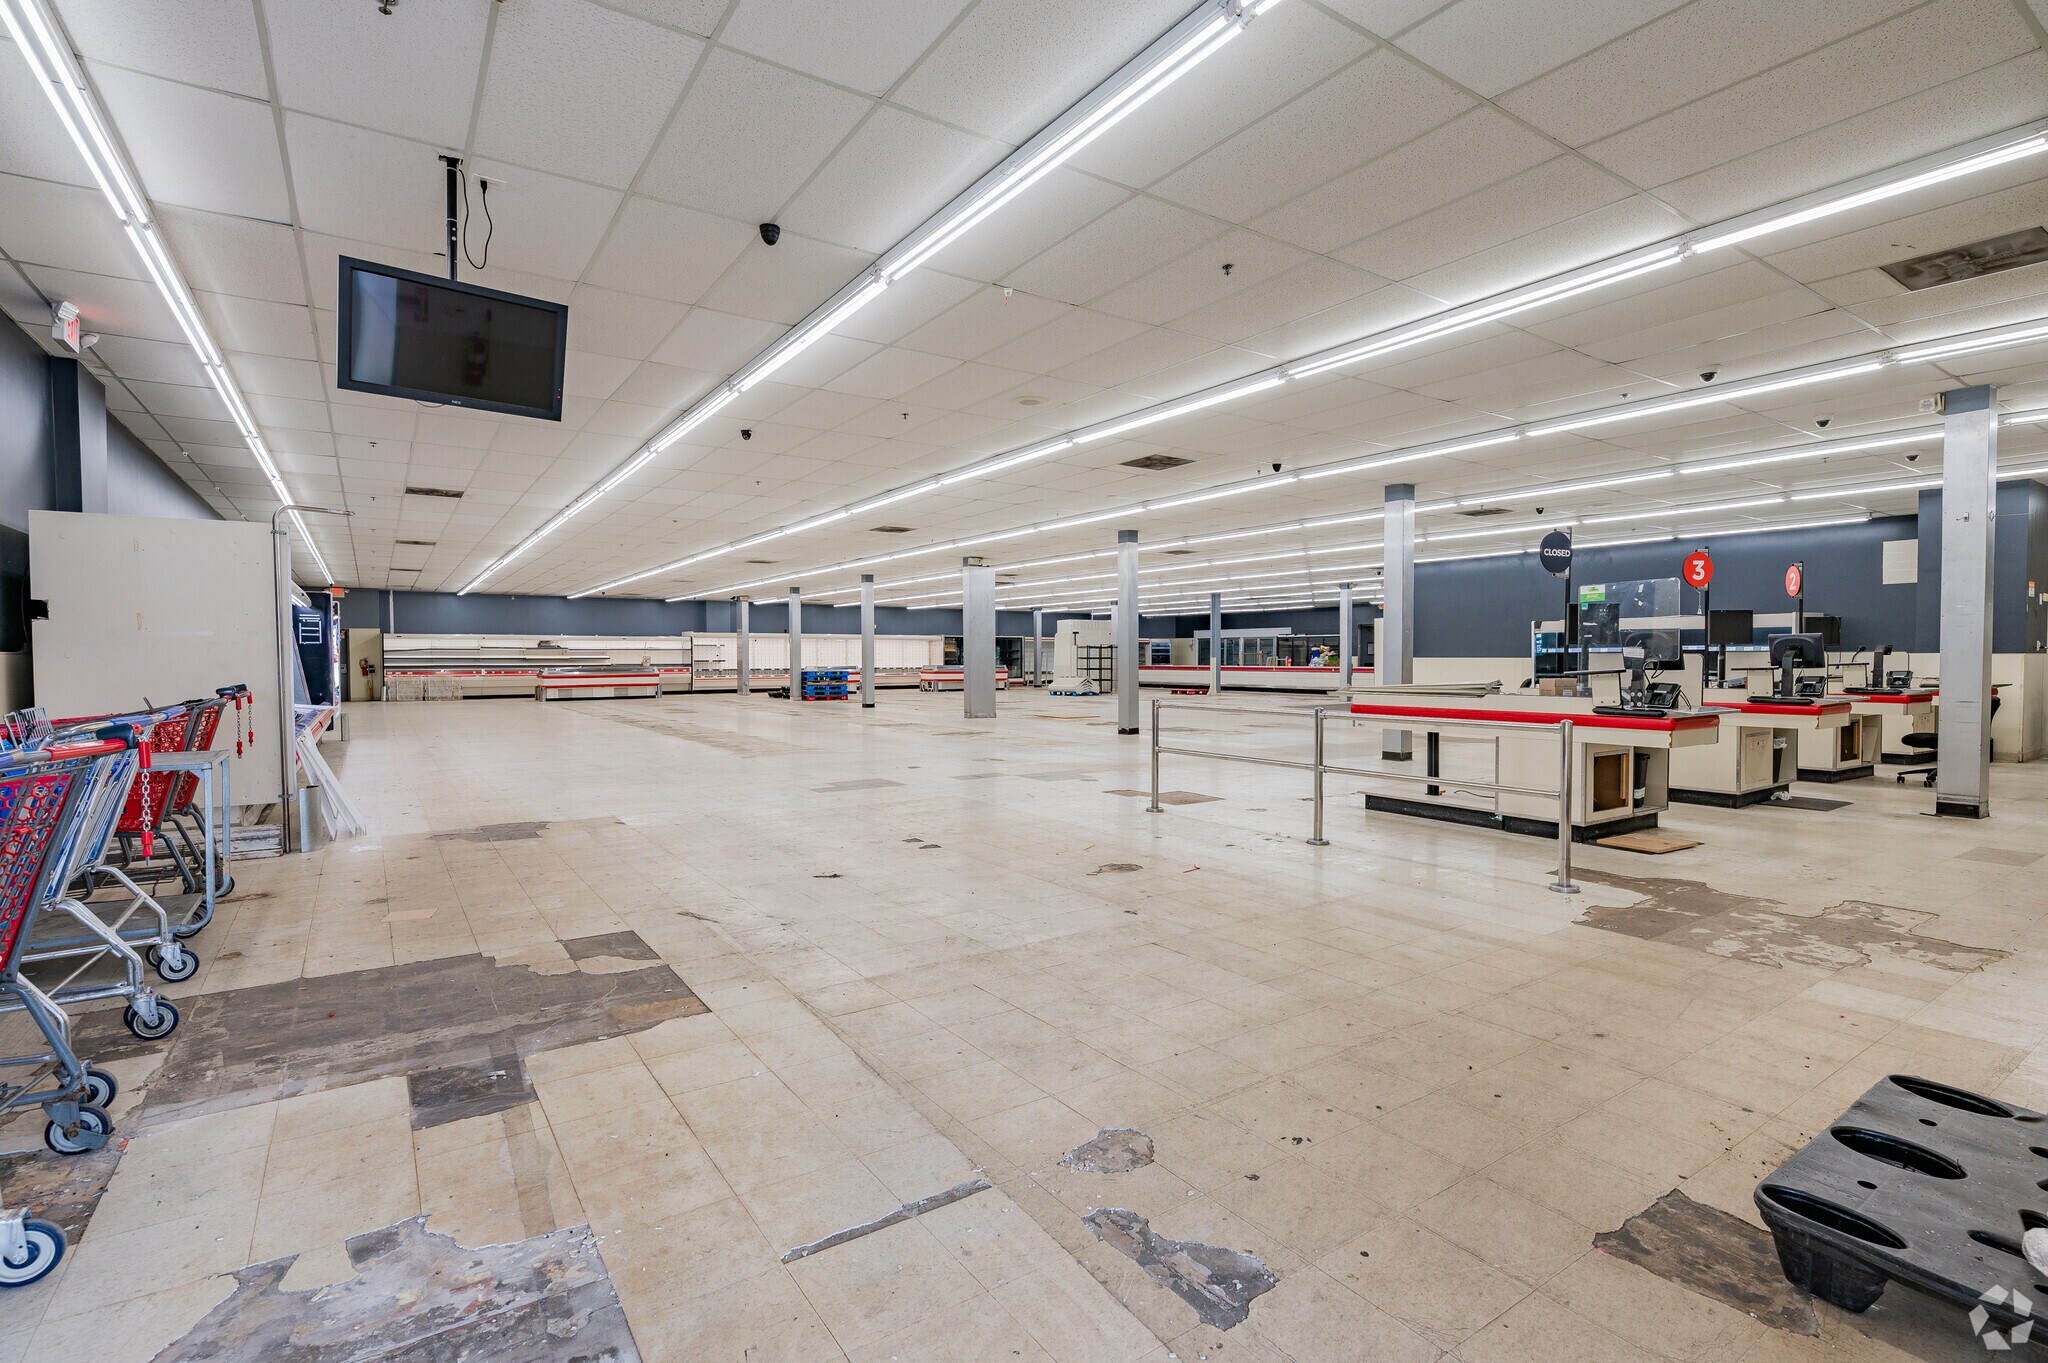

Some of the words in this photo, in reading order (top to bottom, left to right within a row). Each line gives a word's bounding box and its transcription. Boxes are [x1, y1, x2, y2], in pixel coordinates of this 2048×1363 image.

[1544, 548, 1571, 557] CLOSED
[1692, 560, 1705, 580] 3
[1789, 573, 1797, 590] 2
